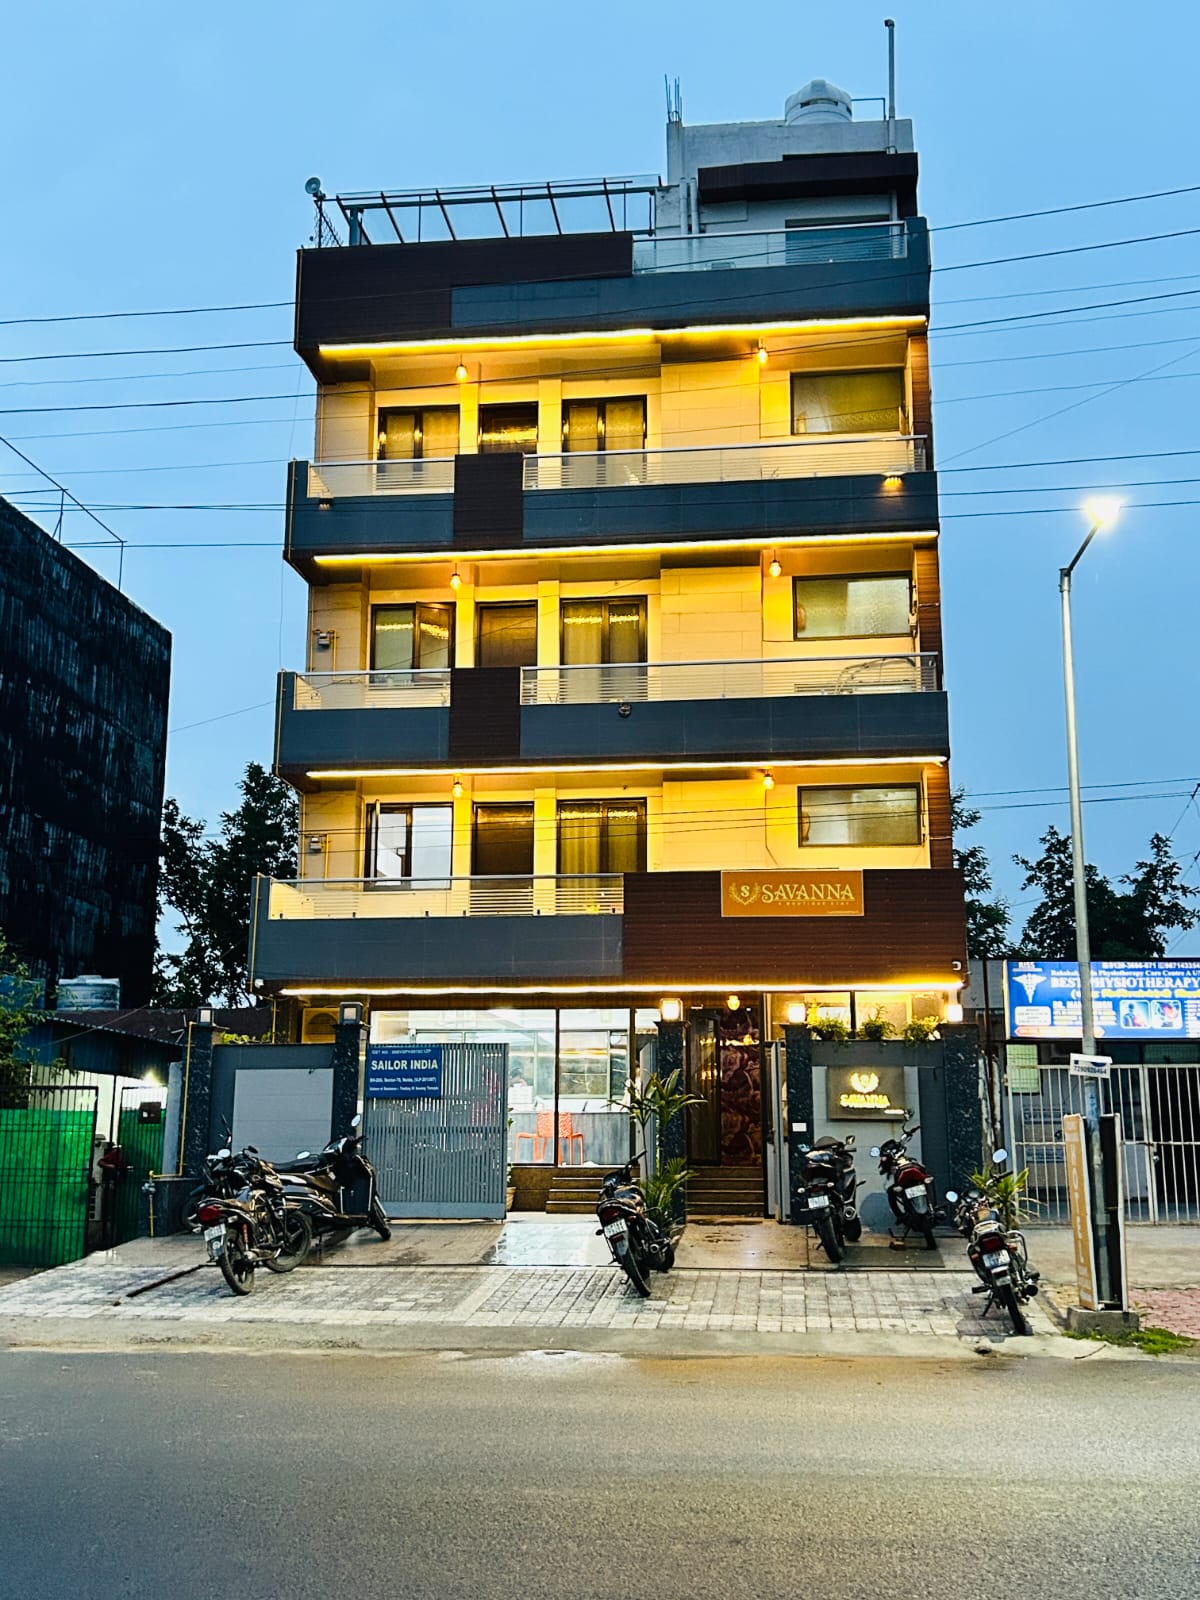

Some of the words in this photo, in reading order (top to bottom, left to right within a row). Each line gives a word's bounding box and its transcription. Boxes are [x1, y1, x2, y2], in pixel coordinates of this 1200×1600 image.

[761, 884, 855, 903] SAVANNA
[1051, 977, 1081, 988] BEST
[371, 1060, 407, 1070] SAILOR
[410, 1059, 438, 1070] INDIA
